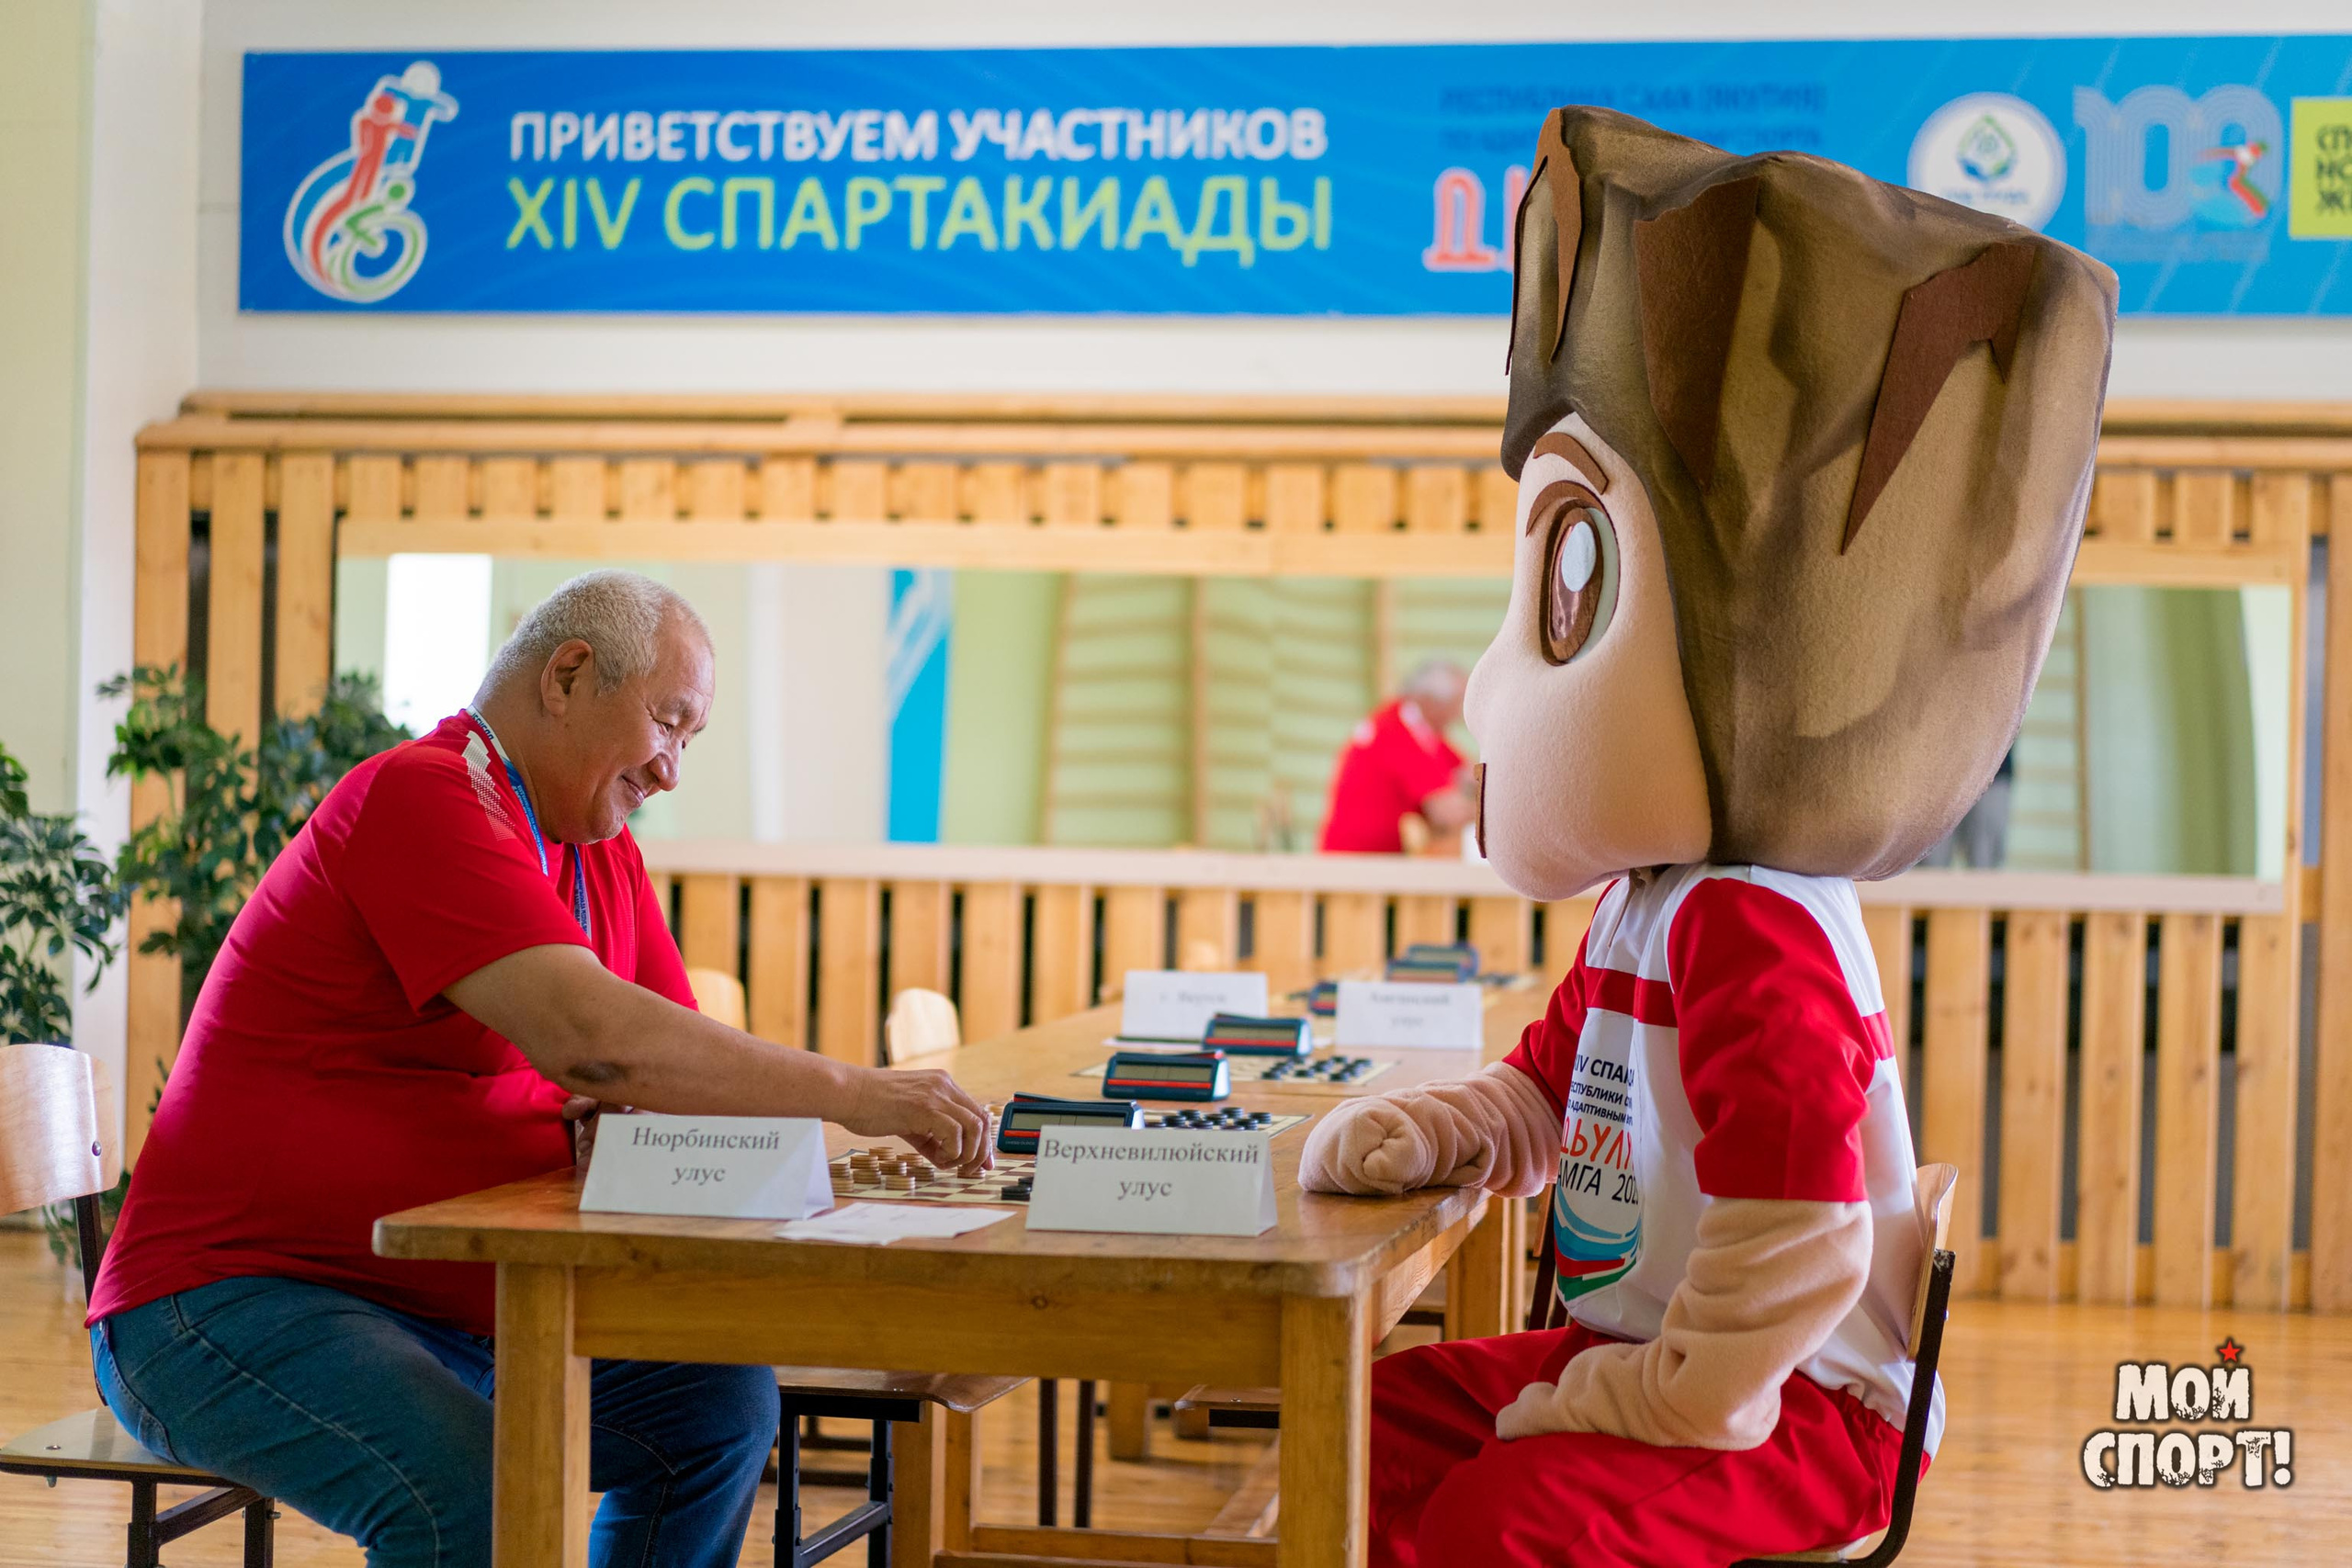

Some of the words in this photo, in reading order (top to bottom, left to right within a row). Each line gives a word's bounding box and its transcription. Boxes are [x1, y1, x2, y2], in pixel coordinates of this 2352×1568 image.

[510, 109, 937, 162] ПРИВЕТСТВУЕМ
[948, 107, 1328, 162] УЧАСТНИКОВ
[506, 176, 642, 251] XIV
[662, 175, 1332, 269] СПАРТАКИАДЫ
[631, 1125, 781, 1153] Нюрбинский
[1043, 1137, 1261, 1165] Верхневилюйский
[670, 1167, 727, 1186] улус
[1116, 1179, 1173, 1201] улус
